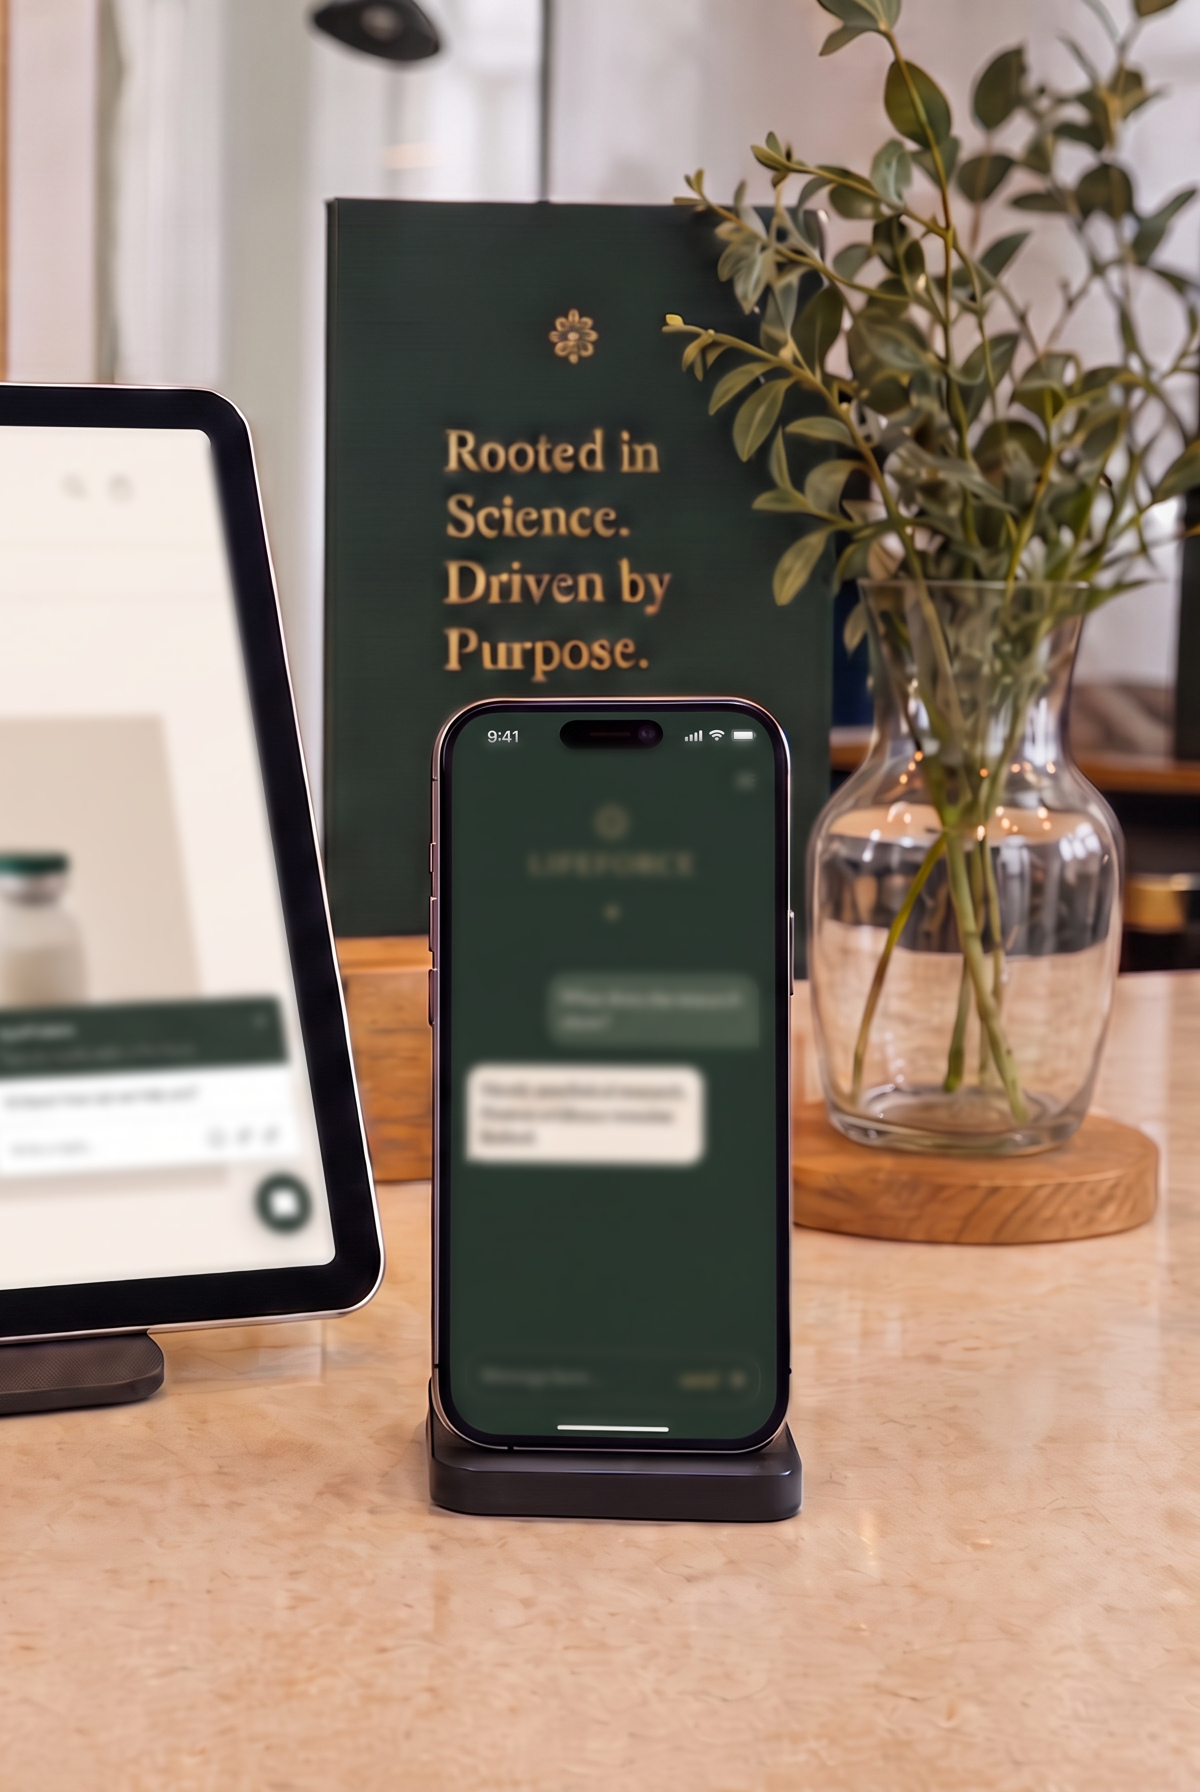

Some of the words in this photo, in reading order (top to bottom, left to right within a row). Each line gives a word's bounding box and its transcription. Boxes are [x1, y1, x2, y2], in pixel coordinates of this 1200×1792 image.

[444, 428, 604, 474] Rooted
[620, 429, 661, 474] in
[445, 495, 631, 539] Science.
[443, 558, 604, 605] Driven
[619, 558, 671, 616] by
[443, 627, 649, 683] Purpose.
[487, 730, 519, 743] 9:41
